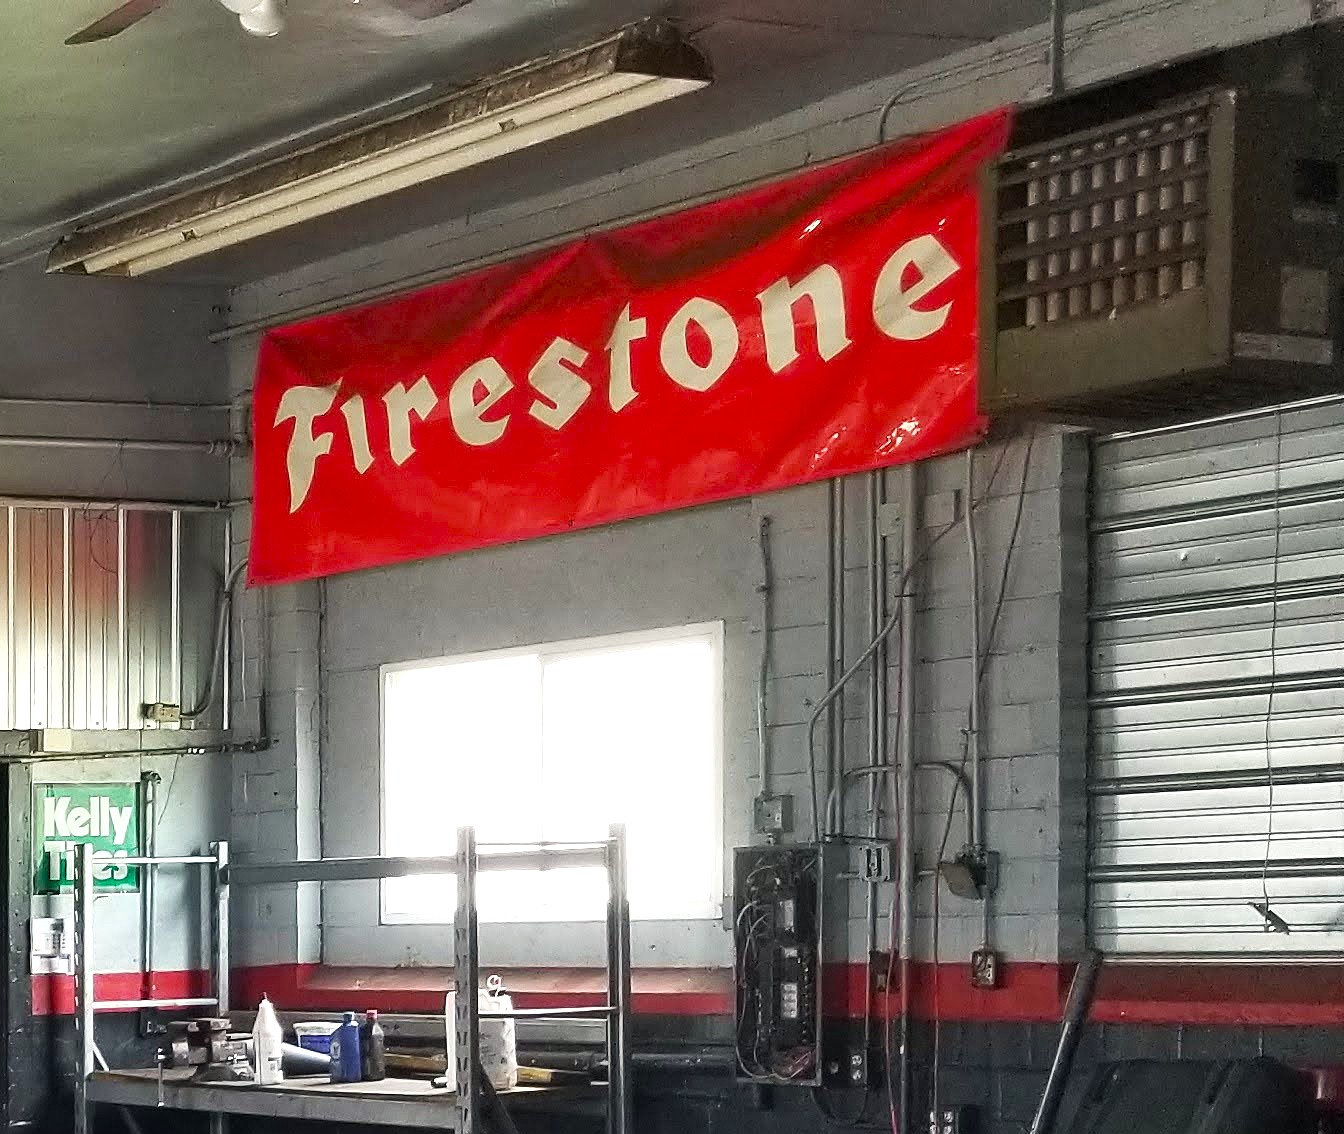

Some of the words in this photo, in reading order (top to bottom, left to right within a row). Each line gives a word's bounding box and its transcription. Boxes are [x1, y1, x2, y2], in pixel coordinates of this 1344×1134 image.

[272, 233, 962, 515] Firestone
[44, 796, 133, 845] Kelly
[44, 840, 128, 880] Ties
